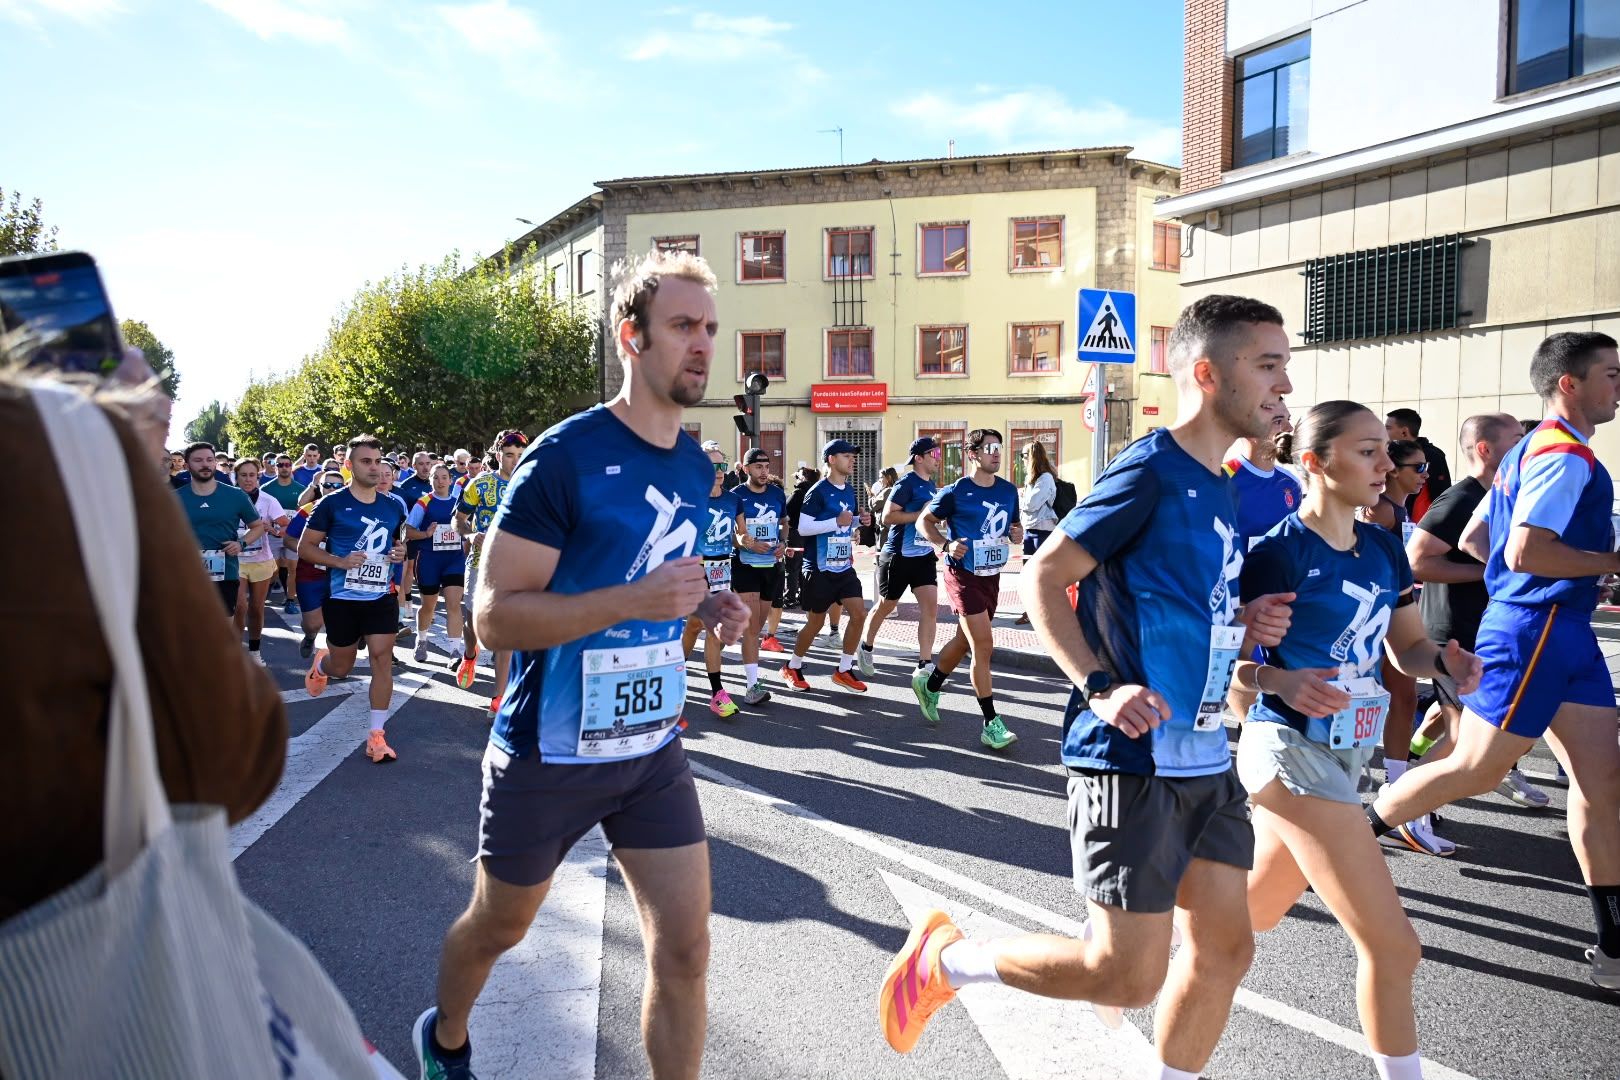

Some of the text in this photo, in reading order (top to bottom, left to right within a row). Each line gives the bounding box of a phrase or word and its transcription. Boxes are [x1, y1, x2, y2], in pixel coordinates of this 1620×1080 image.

[847, 420, 852, 429] 2
[441, 531, 455, 541] 1516
[755, 526, 769, 537] 691
[984, 548, 1002, 563] 766
[614, 676, 663, 717] 583
[1354, 705, 1382, 740] 897
